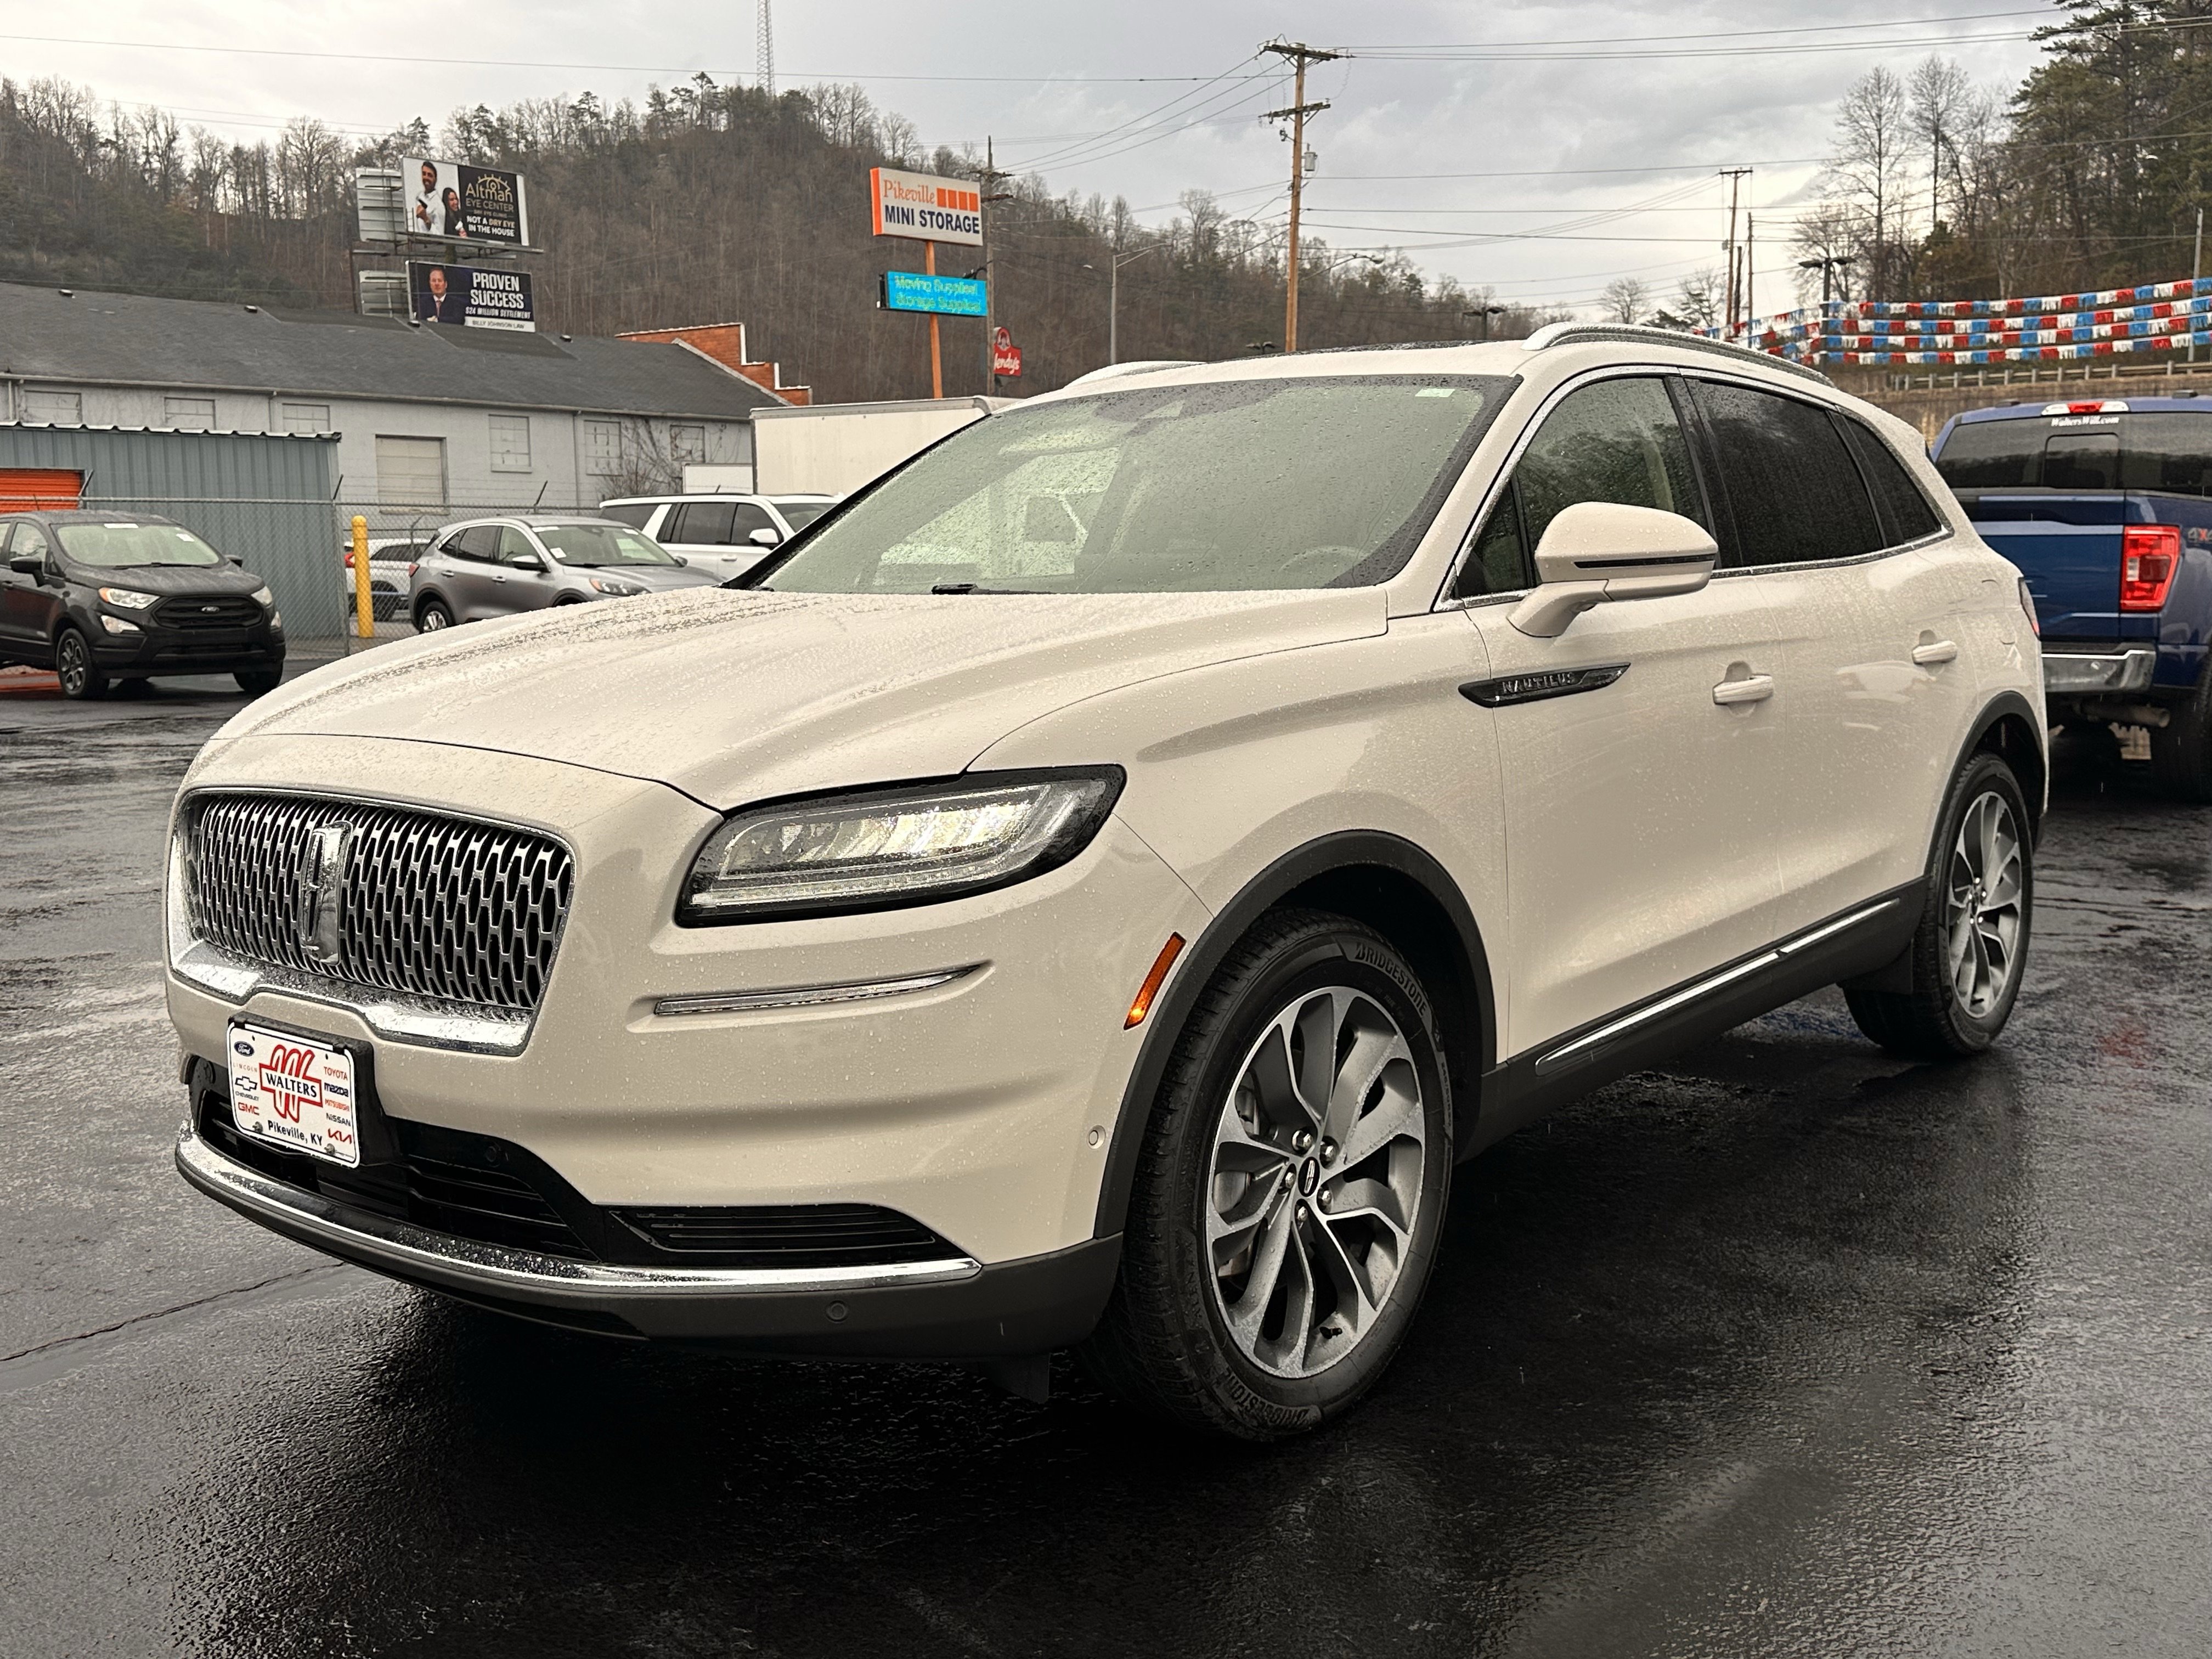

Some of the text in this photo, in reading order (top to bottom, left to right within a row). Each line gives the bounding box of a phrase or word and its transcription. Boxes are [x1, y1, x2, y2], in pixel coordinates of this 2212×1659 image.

[466, 183, 513, 202] Altman
[883, 179, 935, 205] Pikeville
[466, 198, 514, 212] EYE CENTER
[466, 215, 481, 224] NOT
[885, 205, 980, 234] MINI STORAGE
[477, 225, 490, 234] THE
[492, 227, 515, 237] HOUSE
[472, 272, 520, 292] PROVEN
[895, 275, 932, 292] Moving
[470, 289, 524, 309] SUCCESS
[477, 308, 499, 316] MILLION
[500, 309, 531, 319] SETTLEMENT
[994, 353, 1020, 374] endy's
[1502, 673, 1575, 694] NAUTILUS
[1355, 942, 1427, 1017] BRIDGESTONE
[233, 1062, 257, 1073] LINCOLN
[324, 1066, 348, 1081] TOYOTA
[266, 1073, 317, 1098] WALTERS
[235, 1091, 259, 1101] CHEVROLET
[238, 1102, 259, 1116] GMC
[326, 1113, 351, 1127] NISSAN
[268, 1120, 323, 1147] Pikeville, KY
